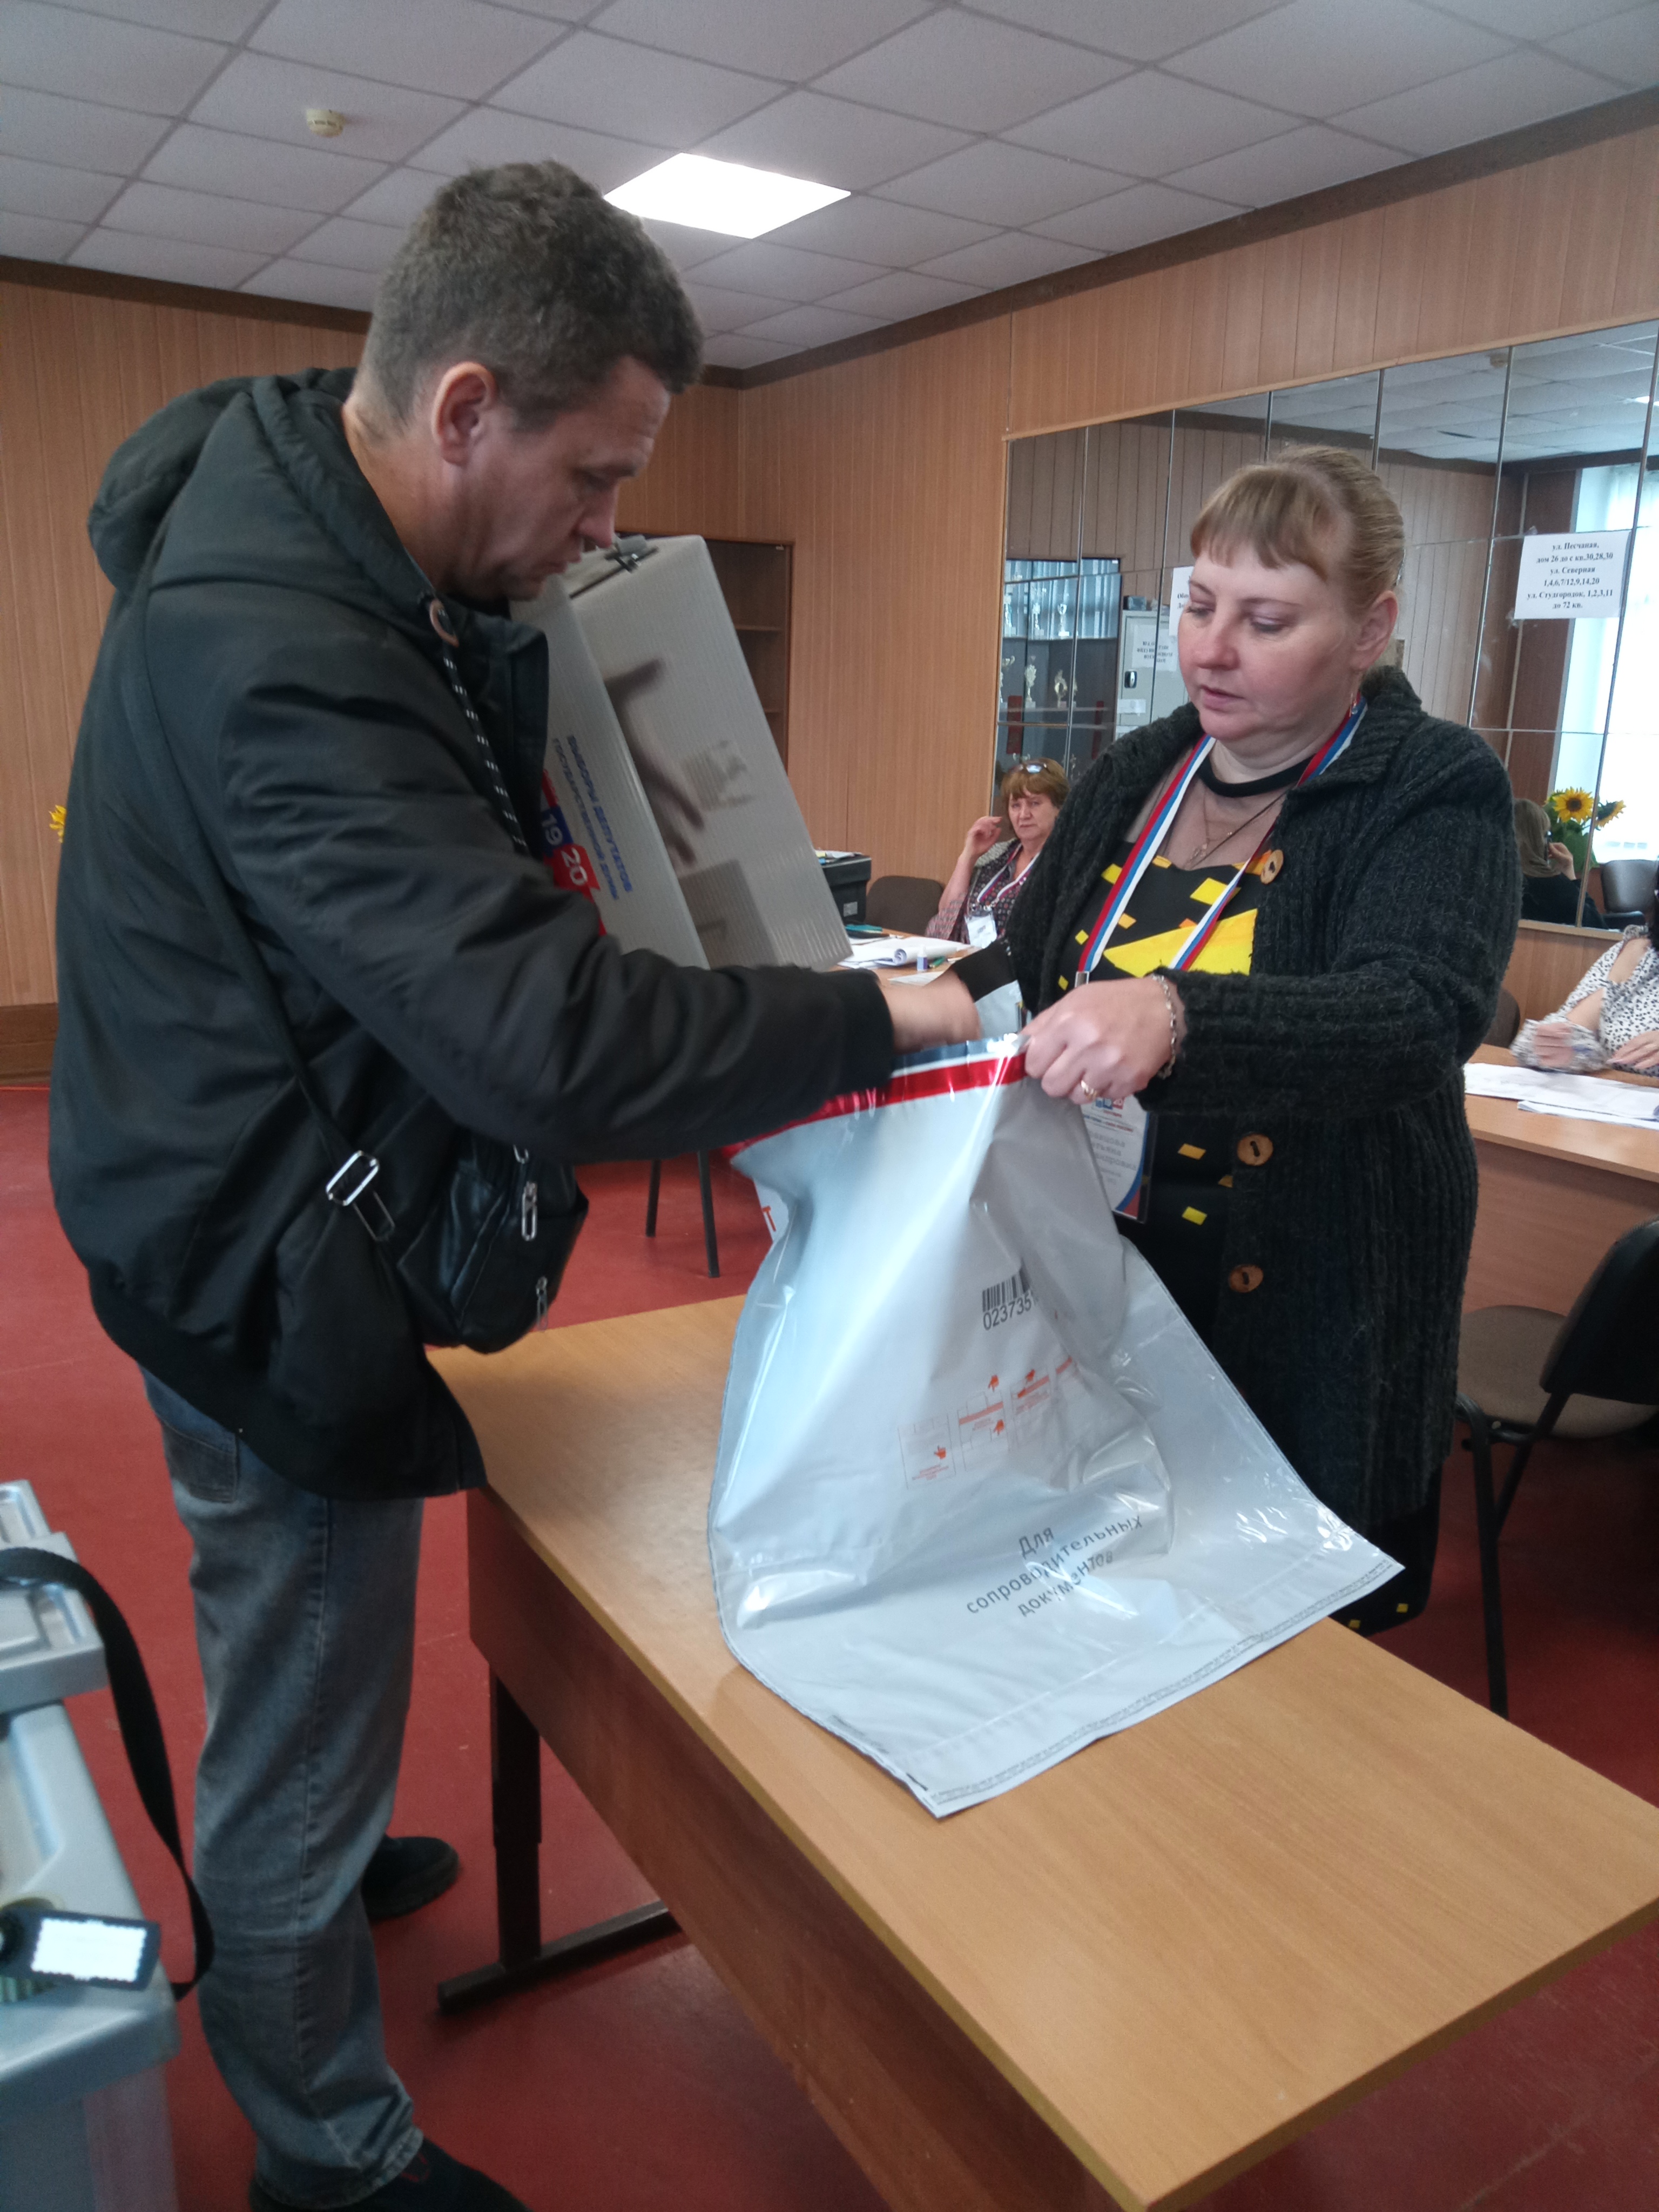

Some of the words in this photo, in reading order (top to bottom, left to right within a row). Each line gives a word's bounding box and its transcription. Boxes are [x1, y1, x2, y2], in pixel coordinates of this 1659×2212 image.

[1562, 567, 1596, 575] Северная
[541, 813, 563, 845] 19
[561, 847, 588, 886] 20
[1019, 1527, 1055, 1557] Для
[966, 1516, 1143, 1614] сопроводительных
